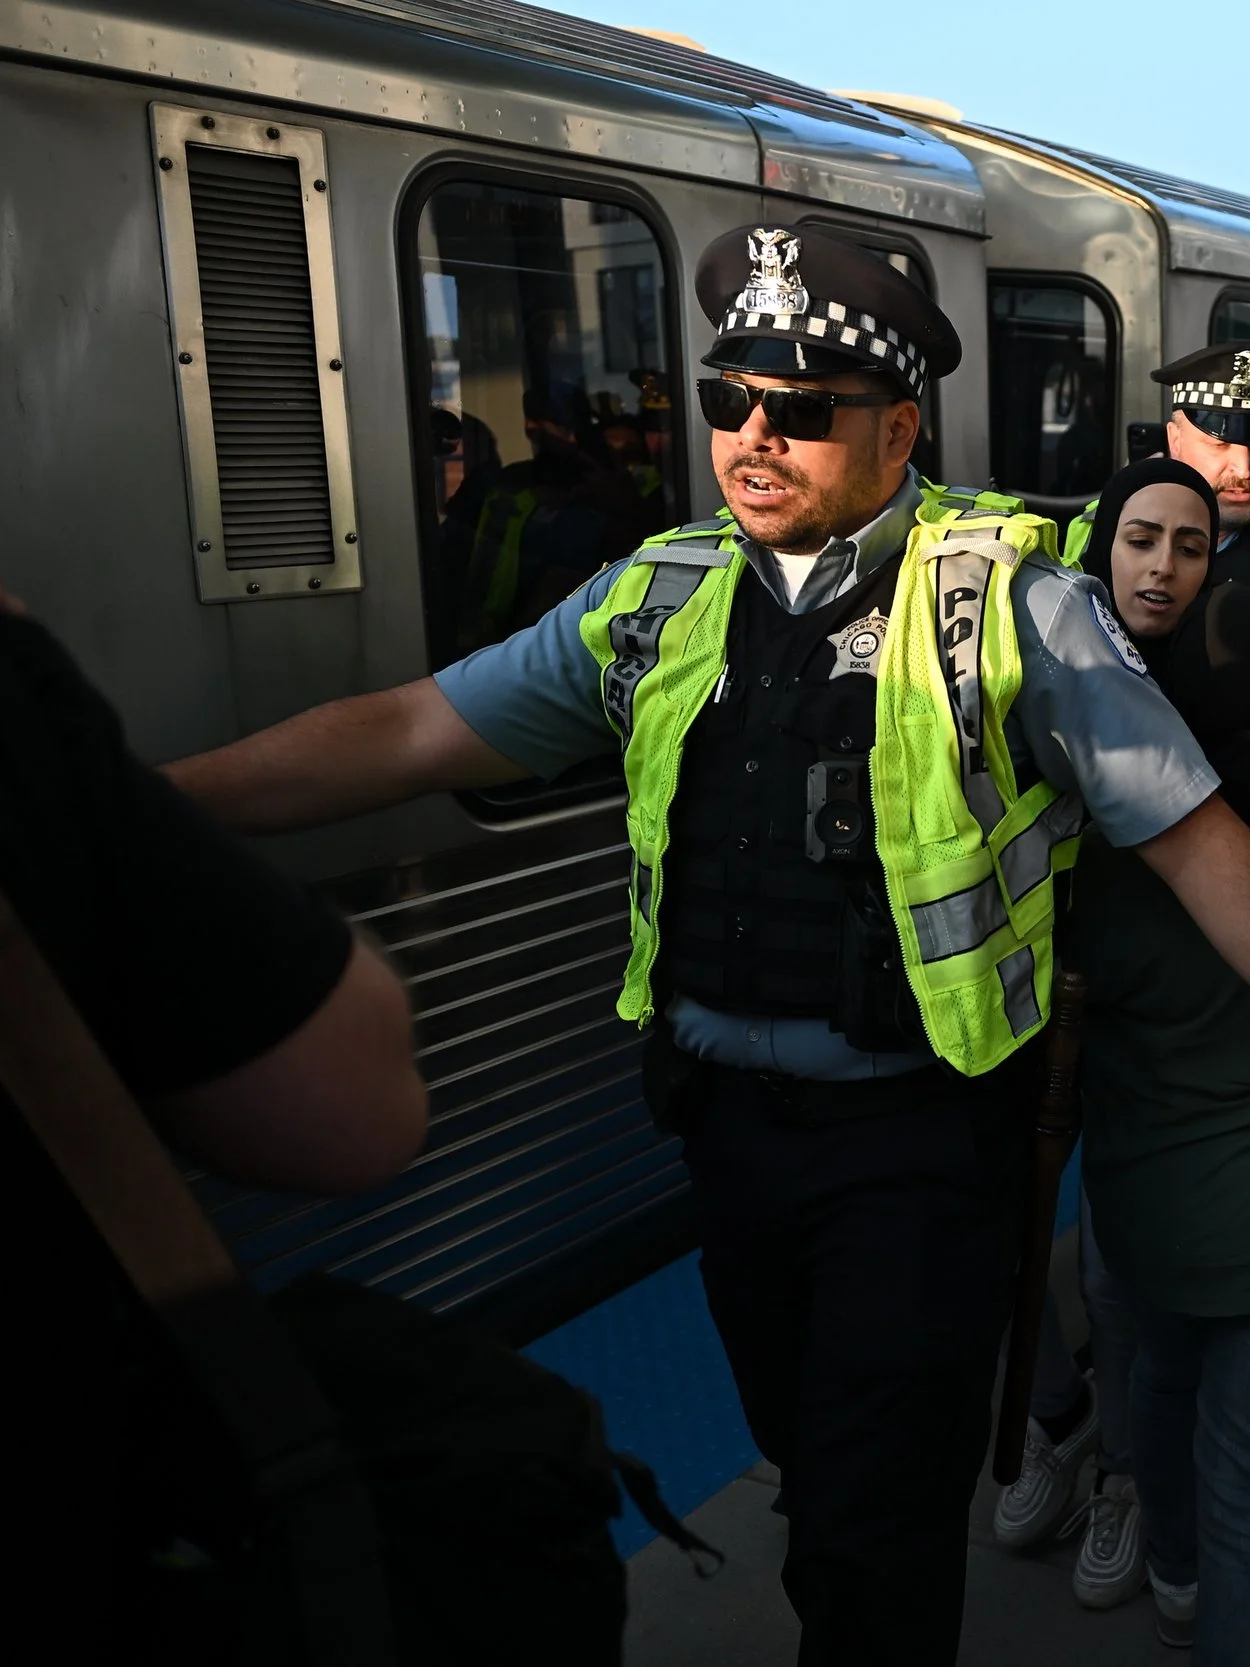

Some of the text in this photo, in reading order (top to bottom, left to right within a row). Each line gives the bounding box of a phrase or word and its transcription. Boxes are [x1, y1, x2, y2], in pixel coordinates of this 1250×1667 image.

[846, 616, 889, 631] POLICE OFFIC
[839, 622, 872, 650] CHICAGO
[849, 661, 870, 669] 15838
